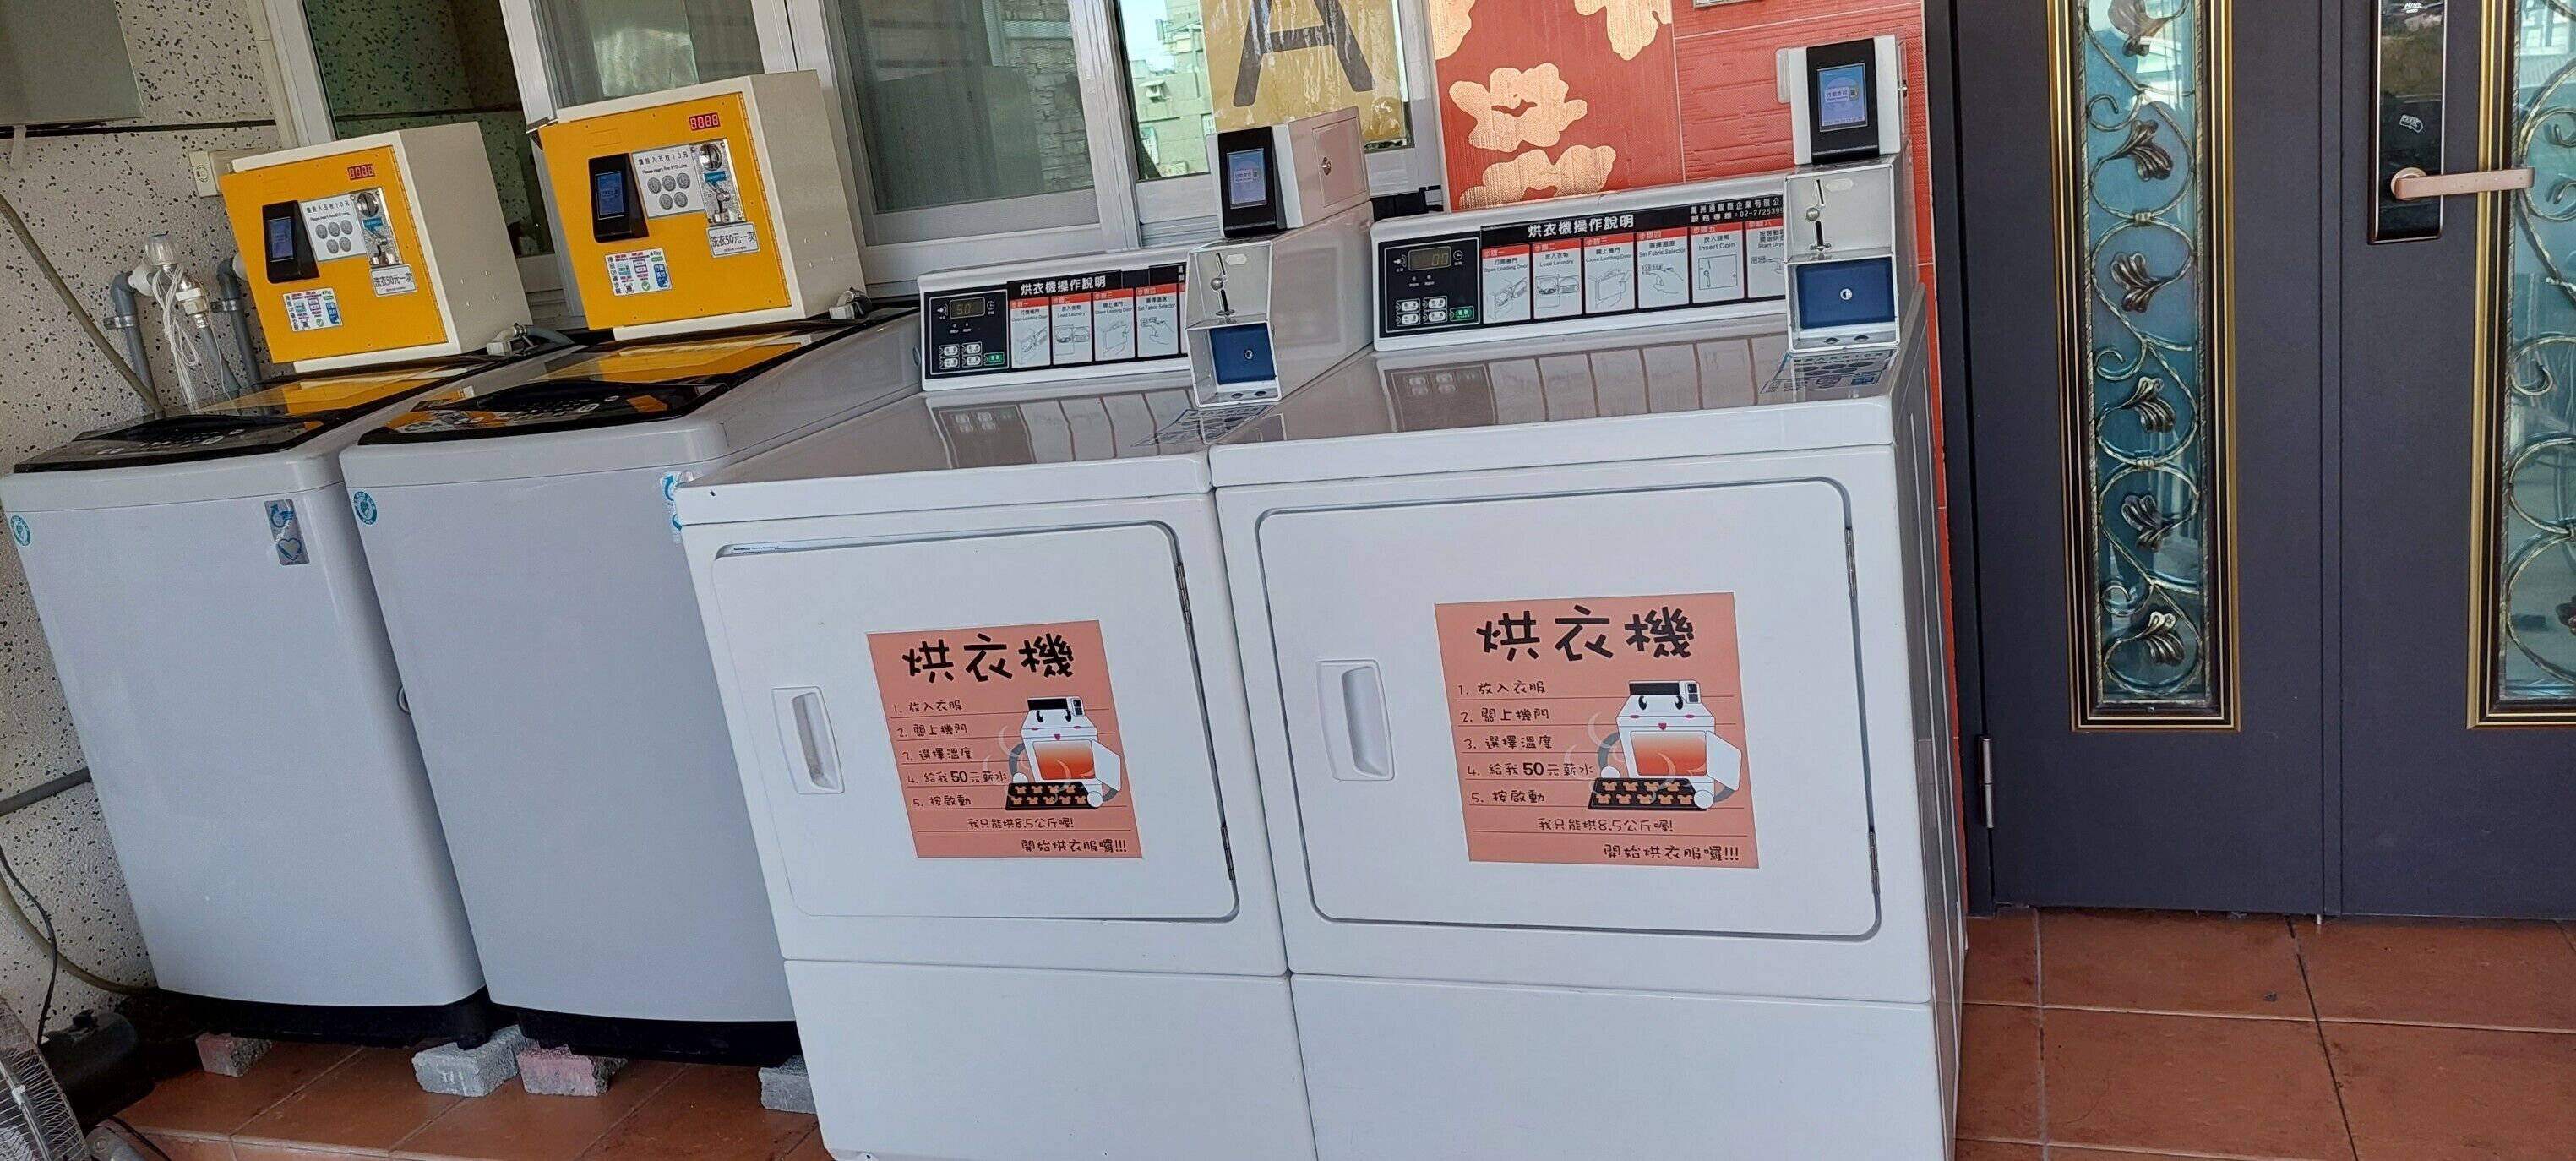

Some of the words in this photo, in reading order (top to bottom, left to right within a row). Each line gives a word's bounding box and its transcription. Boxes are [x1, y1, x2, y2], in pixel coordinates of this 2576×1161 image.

[1528, 214, 1634, 238] 烘衣機操作說明
[711, 231, 756, 248] 洗衣50元一次
[1021, 275, 1107, 296] 烘衣機操作說明
[1476, 604, 1695, 662] 烘衣機
[902, 633, 1076, 684] 烘衣機
[1458, 684, 1469, 695] 1.
[1478, 680, 1545, 695] 放入衣服
[892, 704, 902, 713] 1.
[908, 700, 963, 712] 放入衣服
[1460, 711, 1473, 722] 2.
[1481, 707, 1549, 722] 關上機門
[896, 728, 908, 738] 2.
[913, 723, 967, 737] 關上機門
[1463, 739, 1477, 749] 3.
[1484, 735, 1552, 749] 選擇溫度
[902, 751, 913, 761] 3.
[919, 747, 972, 760] 選擇溫度
[1468, 766, 1480, 776] 4.
[907, 775, 918, 784] 4.
[912, 798, 923, 807] 5.
[929, 794, 972, 807] 按啟動
[1471, 793, 1484, 803] 5.
[1492, 789, 1545, 803] 按啟動
[1604, 843, 1740, 861] 開始烘衣服囉!!!
